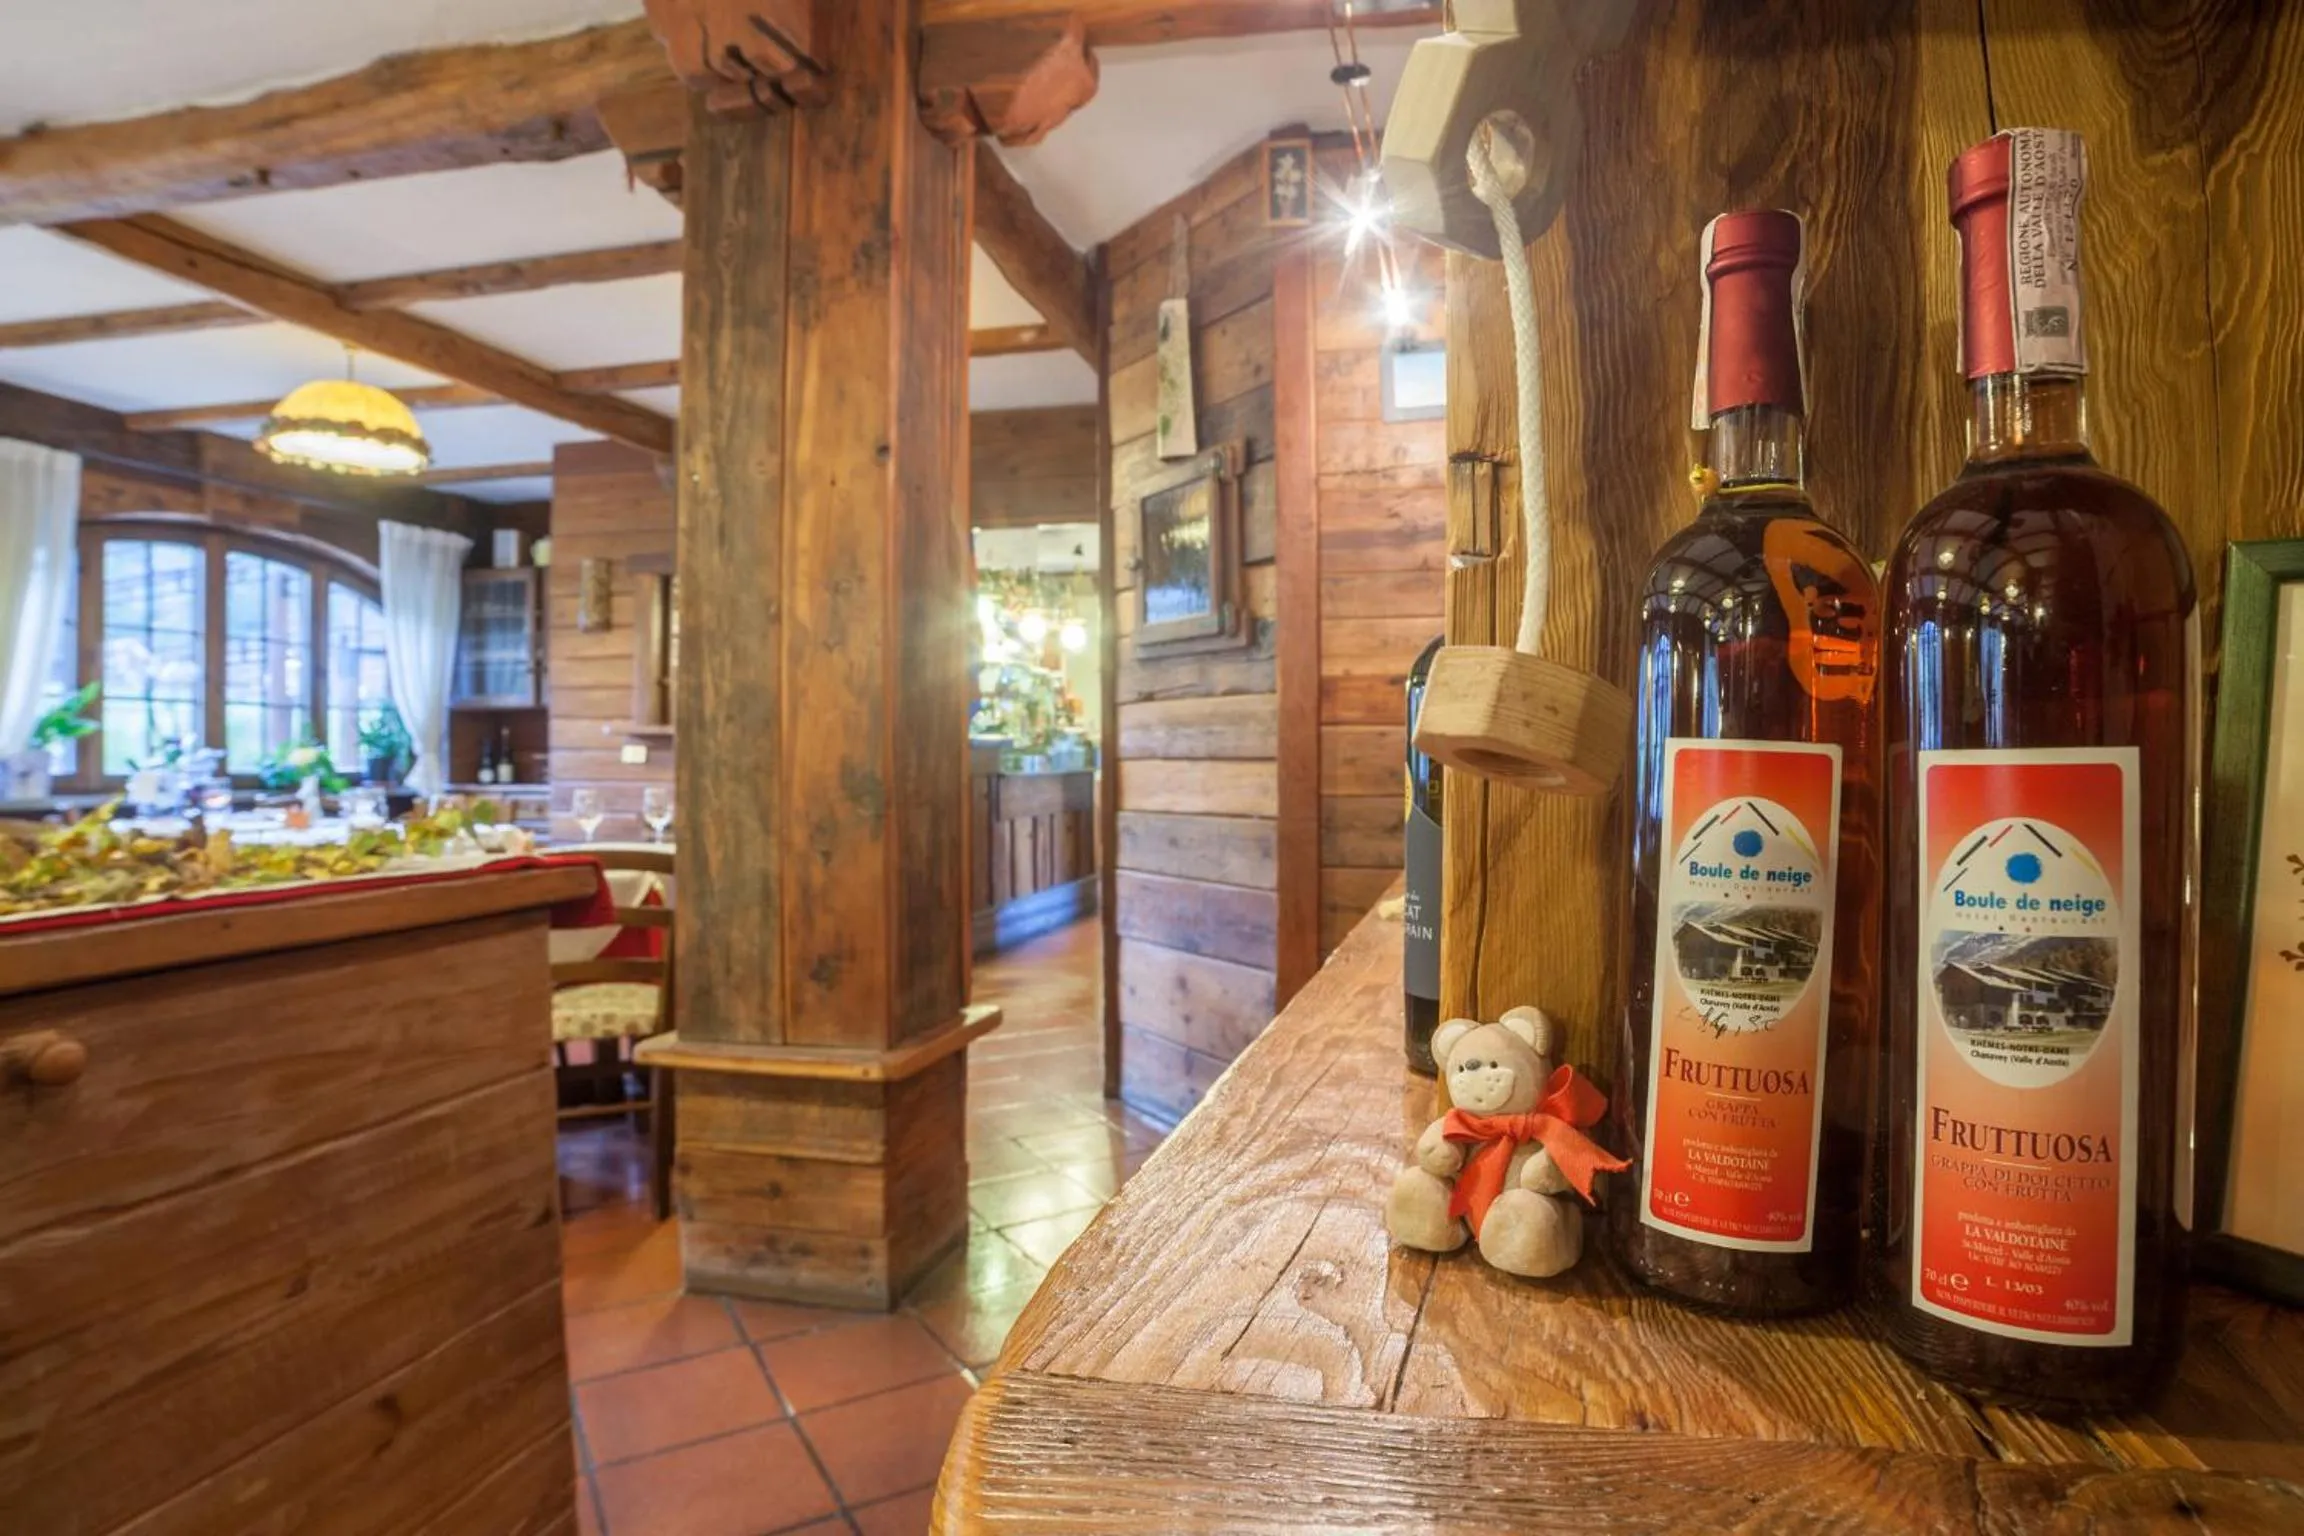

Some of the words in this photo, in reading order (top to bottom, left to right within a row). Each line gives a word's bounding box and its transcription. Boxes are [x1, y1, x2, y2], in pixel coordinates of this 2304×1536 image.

[2018, 129, 2033, 214] AUTONOMA
[2031, 128, 2046, 186] D'AOST
[2018, 219, 2033, 286] REGIONE
[2031, 243, 2046, 289] DELLA
[1689, 861, 1732, 879] Boule
[1740, 864, 1760, 880] de
[1767, 866, 1812, 887] neige
[1955, 889, 2007, 909] Boule
[2016, 892, 2040, 911] de
[2049, 893, 2106, 917] neige
[1664, 1047, 1810, 1095] FRUTTUOSA
[1931, 1105, 2113, 1164] FRUTTUOSA
[1931, 1154, 1988, 1179] GRAPPA
[1994, 1168, 2010, 1182] DI
[1963, 1177, 1999, 1193] CON
[2004, 1183, 2072, 1202] FRUTTA
[1965, 1223, 1981, 1238] LA
[1984, 1228, 2069, 1252] VALDOTAINE
[1924, 1268, 1937, 1281] 70
[1938, 1273, 1947, 1286] cl
[2004, 1279, 2044, 1295] 13/03
